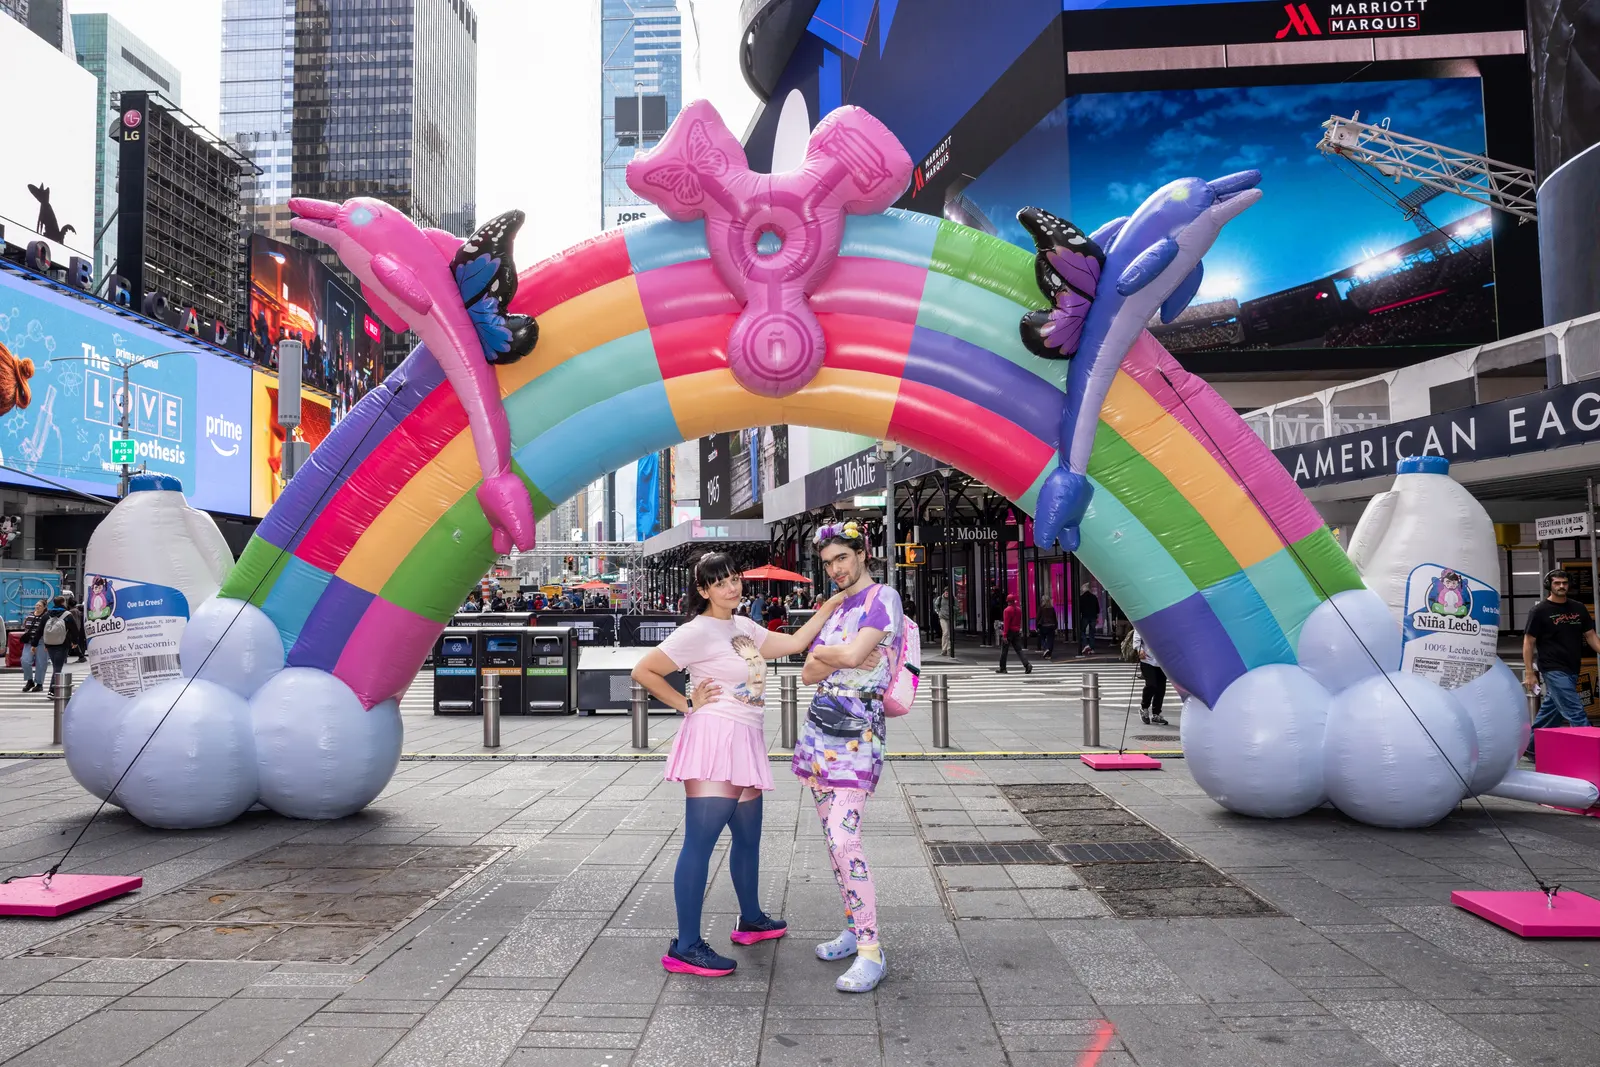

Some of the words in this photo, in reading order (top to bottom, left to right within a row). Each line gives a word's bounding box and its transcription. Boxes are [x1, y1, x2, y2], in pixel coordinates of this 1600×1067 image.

[1331, 0, 1428, 15] MARRIOTT
[1331, 16, 1417, 32] MARQUIS
[124, 131, 140, 141] LG
[925, 135, 952, 169] MARRIOTT
[925, 151, 949, 181] MARQUIS
[617, 212, 647, 222] JOBS
[81, 342, 110, 372] The
[93, 378, 177, 428] LOVE
[205, 413, 243, 441] prime
[1294, 416, 1476, 482] AMERICAN
[844, 454, 876, 492] Mobile
[1537, 518, 1561, 529] PEDESTRIAN
[1561, 516, 1572, 526] FLOW
[1572, 515, 1584, 524] ZONE
[956, 527, 998, 540] Mobile
[1538, 529, 1548, 537] KEEP
[1548, 527, 1564, 536] MOVING
[126, 601, 137, 609] Que
[145, 598, 164, 607] Crees?
[96, 618, 121, 633] Leche
[1417, 615, 1446, 630] Niña
[1448, 618, 1478, 633] Leche
[100, 645, 117, 655] Leche
[118, 644, 127, 652] de
[128, 639, 177, 651] Vacacornio
[1424, 642, 1448, 653] 100%
[1449, 645, 1471, 655] Leche
[1471, 647, 1479, 655] de
[1414, 663, 1438, 671] Nutricional
[1415, 658, 1441, 666] Información
